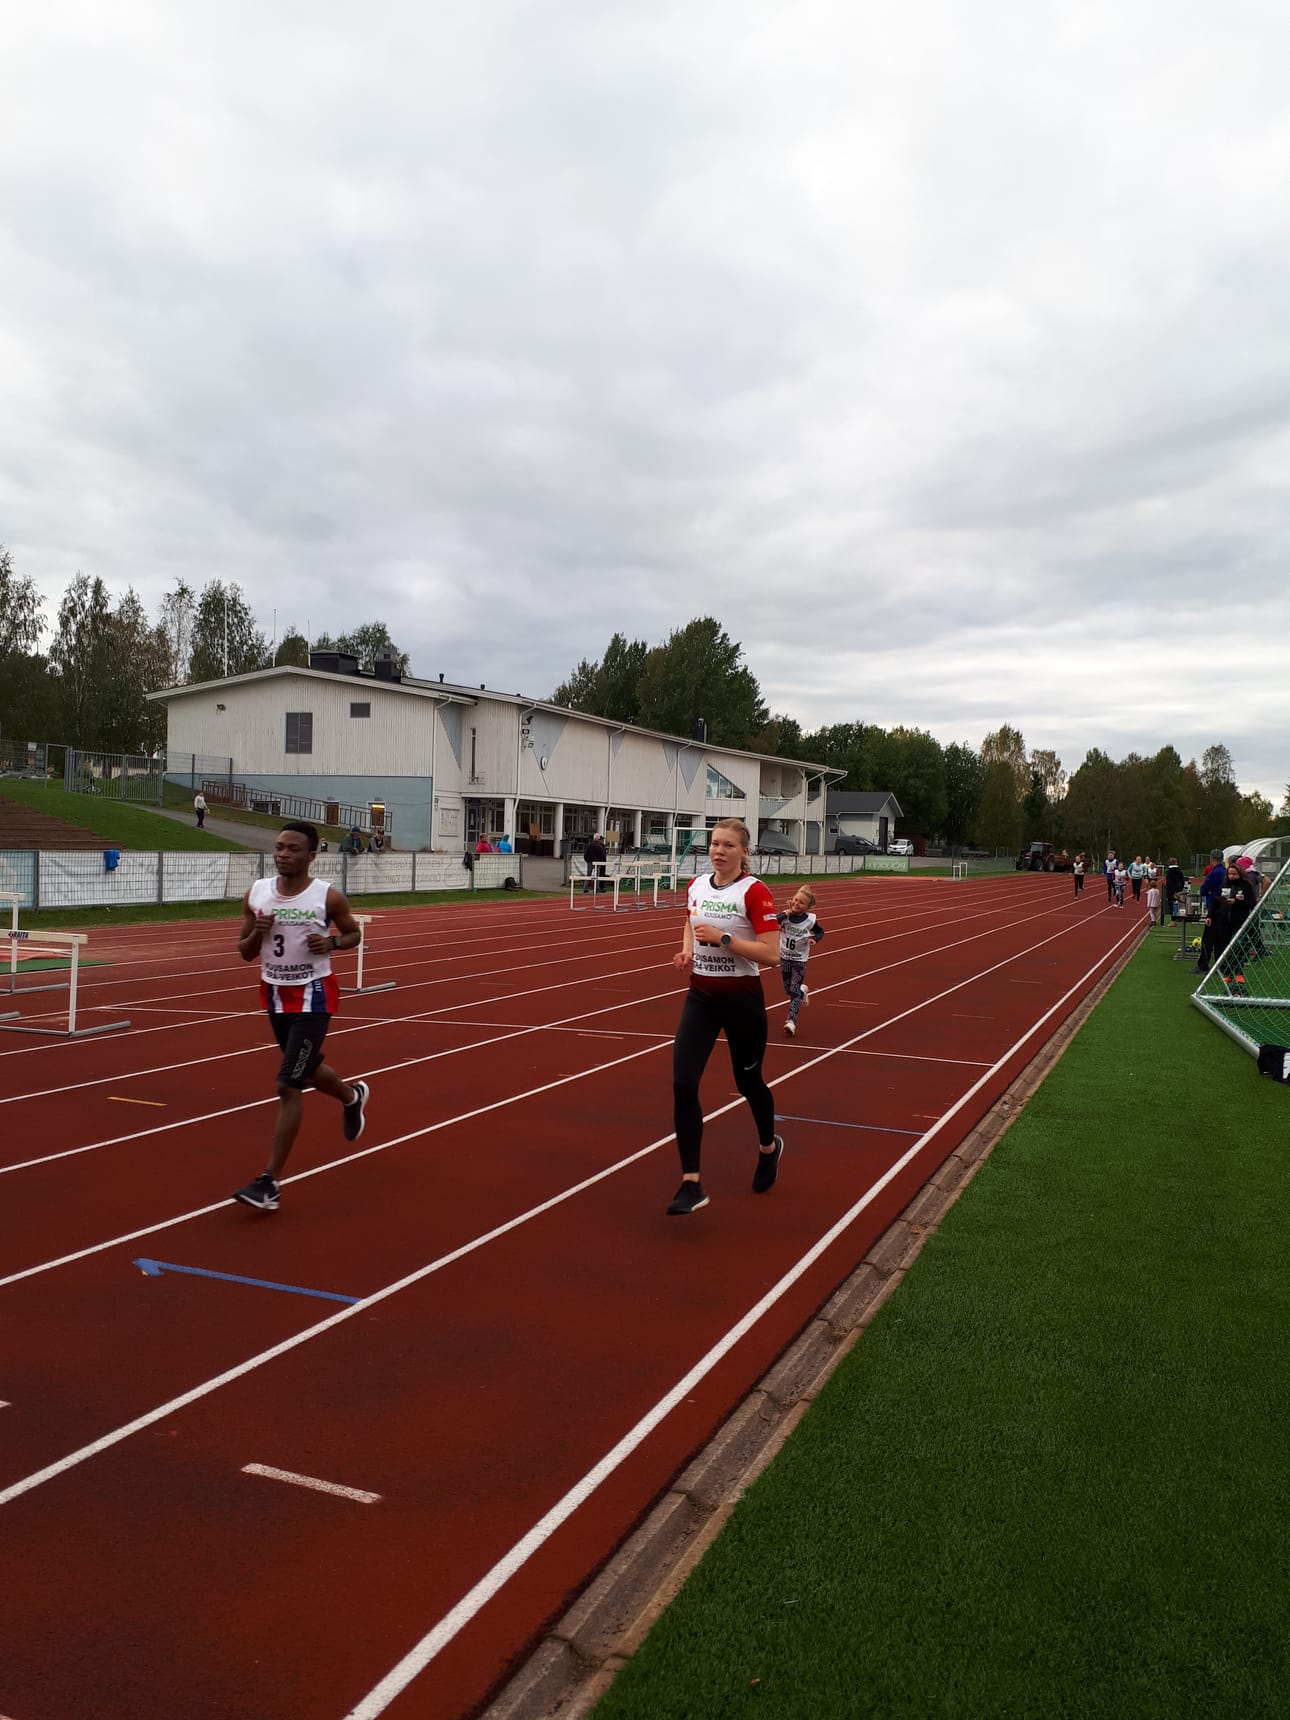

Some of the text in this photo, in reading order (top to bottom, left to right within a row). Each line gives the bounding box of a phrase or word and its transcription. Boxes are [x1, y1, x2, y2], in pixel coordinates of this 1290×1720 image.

[701, 900, 738, 912] PRISMA
[272, 908, 317, 919] PRISMA
[273, 934, 285, 957] 3
[786, 938, 796, 950] 16
[693, 953, 734, 964] USAMON
